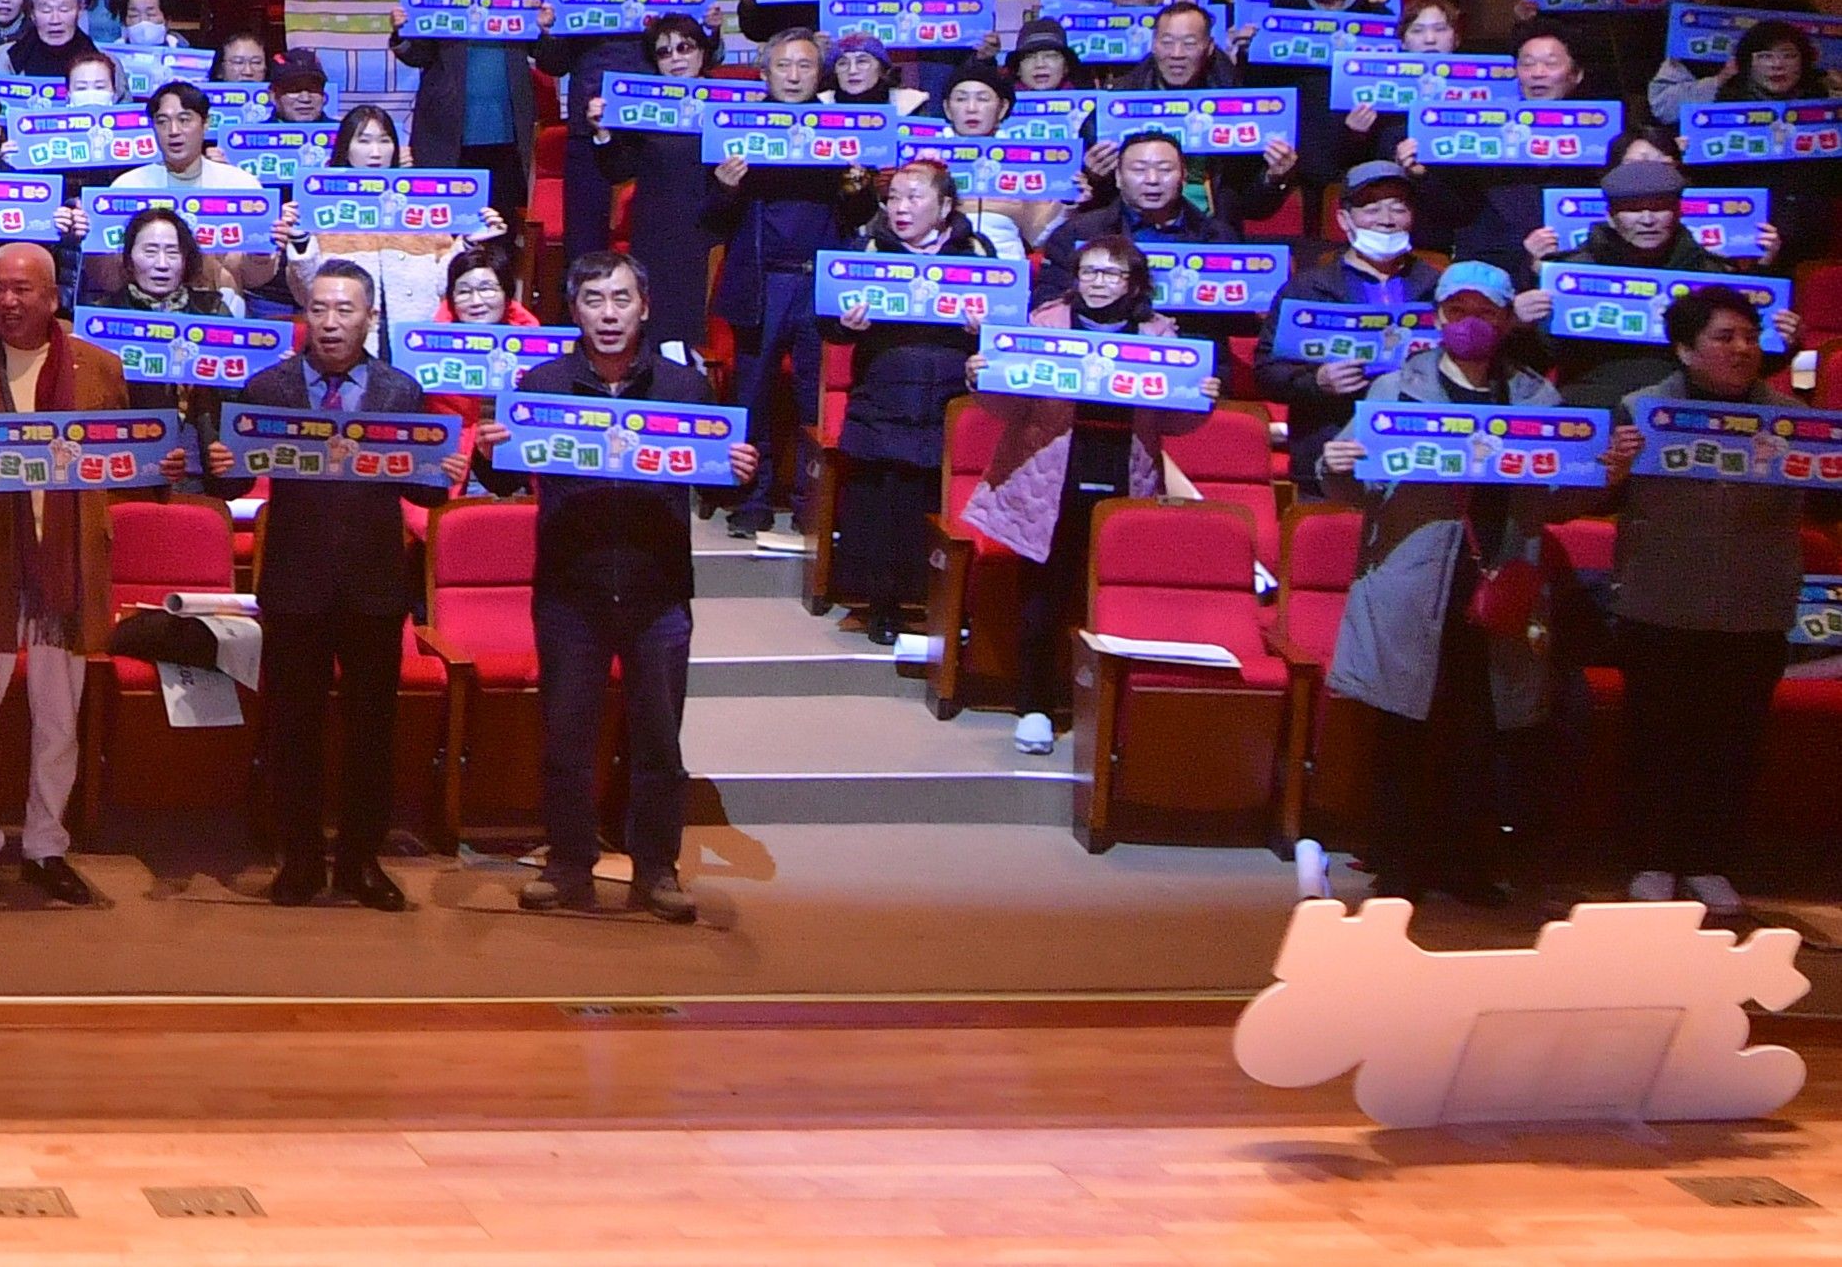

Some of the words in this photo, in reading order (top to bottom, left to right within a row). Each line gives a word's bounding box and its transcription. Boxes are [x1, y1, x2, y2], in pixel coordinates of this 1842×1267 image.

[31, 139, 88, 163] 다함께
[112, 137, 154, 157] 실천
[316, 202, 377, 226] 다함께
[404, 206, 449, 225] 실천
[936, 295, 985, 315] 실천
[1007, 362, 1079, 390] 다함께
[1111, 373, 1164, 397] 실천
[80, 454, 133, 480] 실천
[246, 445, 322, 473] 다함께
[354, 453, 411, 476] 실천
[523, 436, 602, 468] 다함께
[635, 448, 693, 474] 실천
[1385, 444, 1464, 474] 다함께
[1499, 451, 1557, 475] 실천
